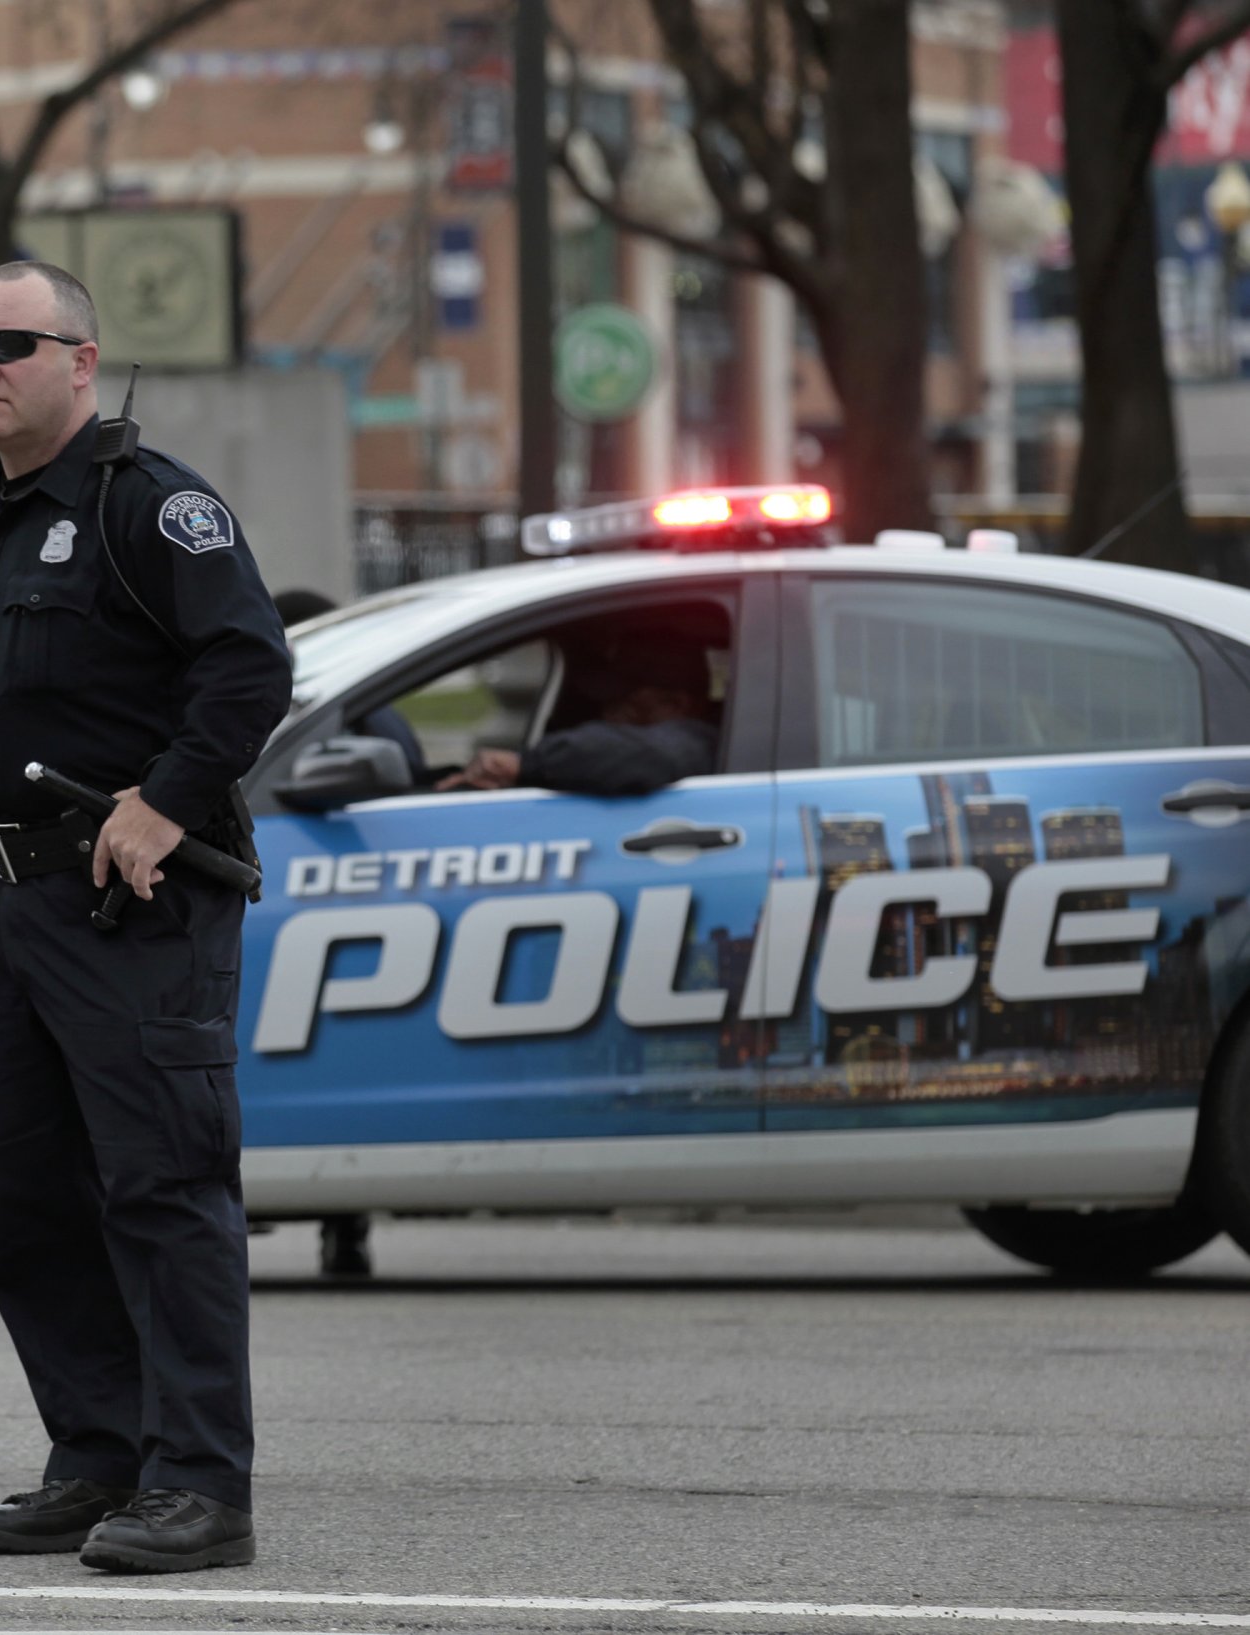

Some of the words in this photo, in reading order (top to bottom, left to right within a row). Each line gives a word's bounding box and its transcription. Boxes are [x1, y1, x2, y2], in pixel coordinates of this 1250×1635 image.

[165, 496, 217, 520] DETROIT
[193, 536, 228, 549] POLICE
[286, 839, 591, 897] DETROIT
[252, 853, 1171, 1053] POLICE
